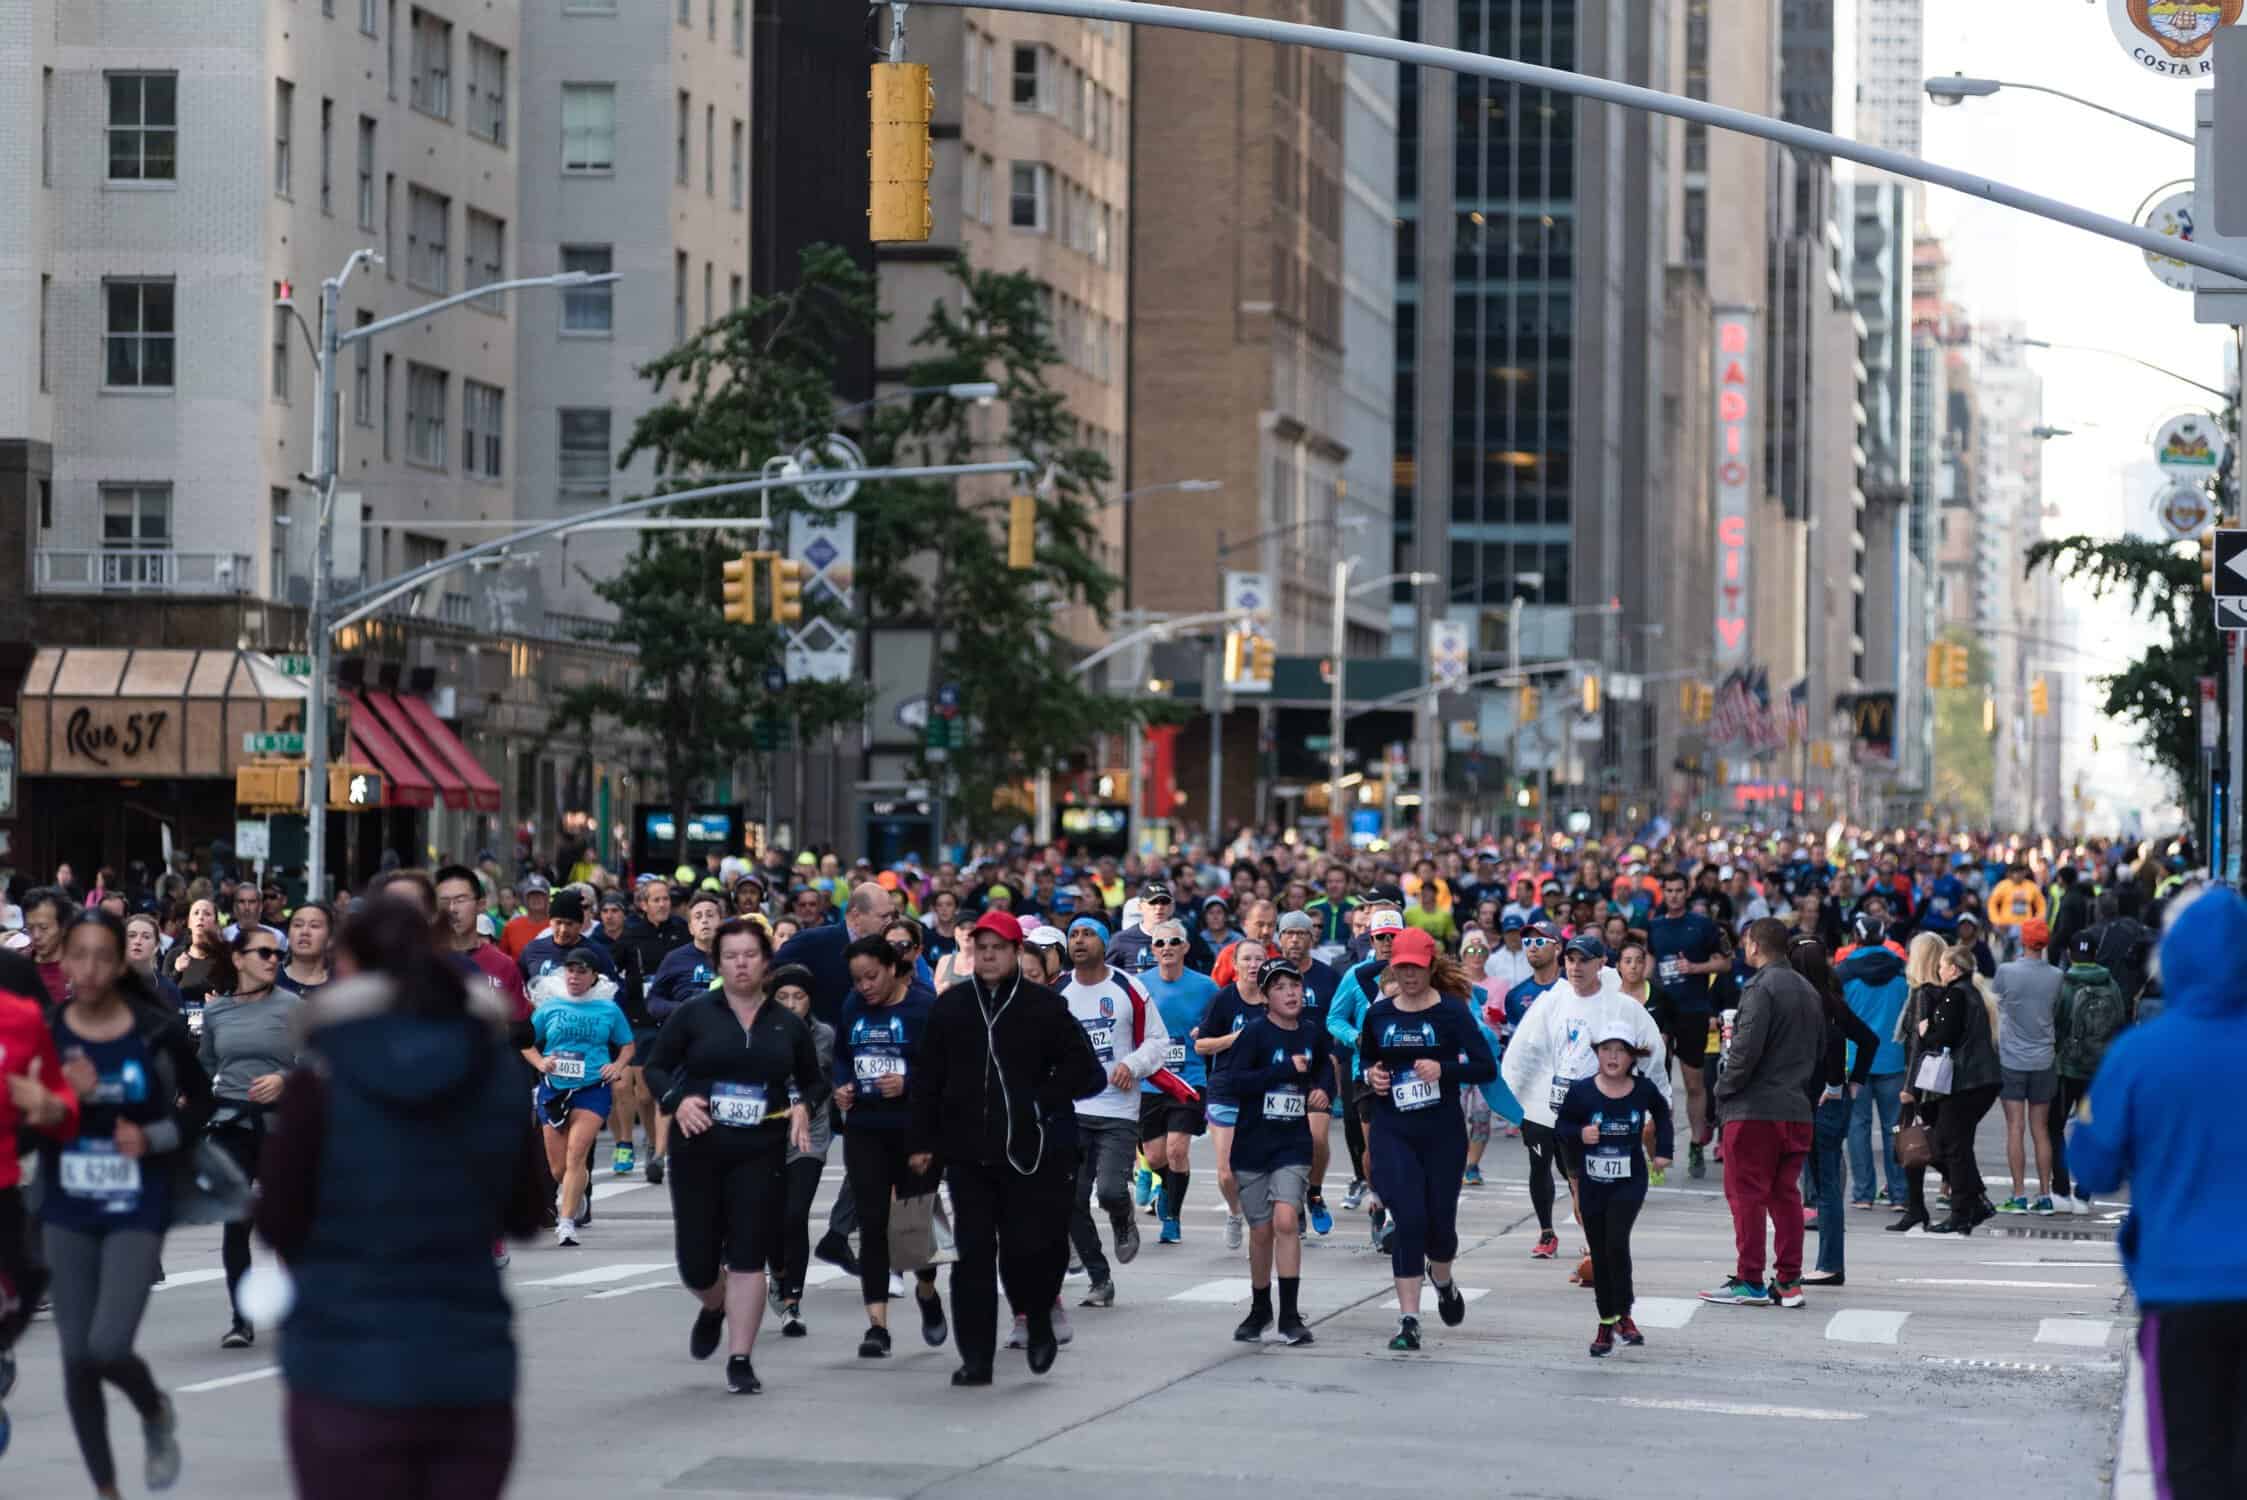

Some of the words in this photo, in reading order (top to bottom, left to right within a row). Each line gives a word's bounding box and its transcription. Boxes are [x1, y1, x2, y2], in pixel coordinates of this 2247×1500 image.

[2133, 47, 2192, 76] COSTA
[1719, 322, 1748, 487] RADIO
[1716, 515, 1746, 649] CITY
[67, 705, 117, 767] Rue
[122, 709, 168, 755] 57
[1092, 1031, 1106, 1047] 62
[855, 1059, 865, 1074] K
[1395, 1087, 1405, 1101] G
[1411, 1081, 1432, 1100] 470
[711, 1100, 721, 1115] K
[727, 1101, 760, 1121] 3834
[1266, 1095, 1275, 1110] K
[1283, 1096, 1303, 1113] 472
[1587, 1159, 1597, 1174] K
[1603, 1159, 1622, 1175] 471
